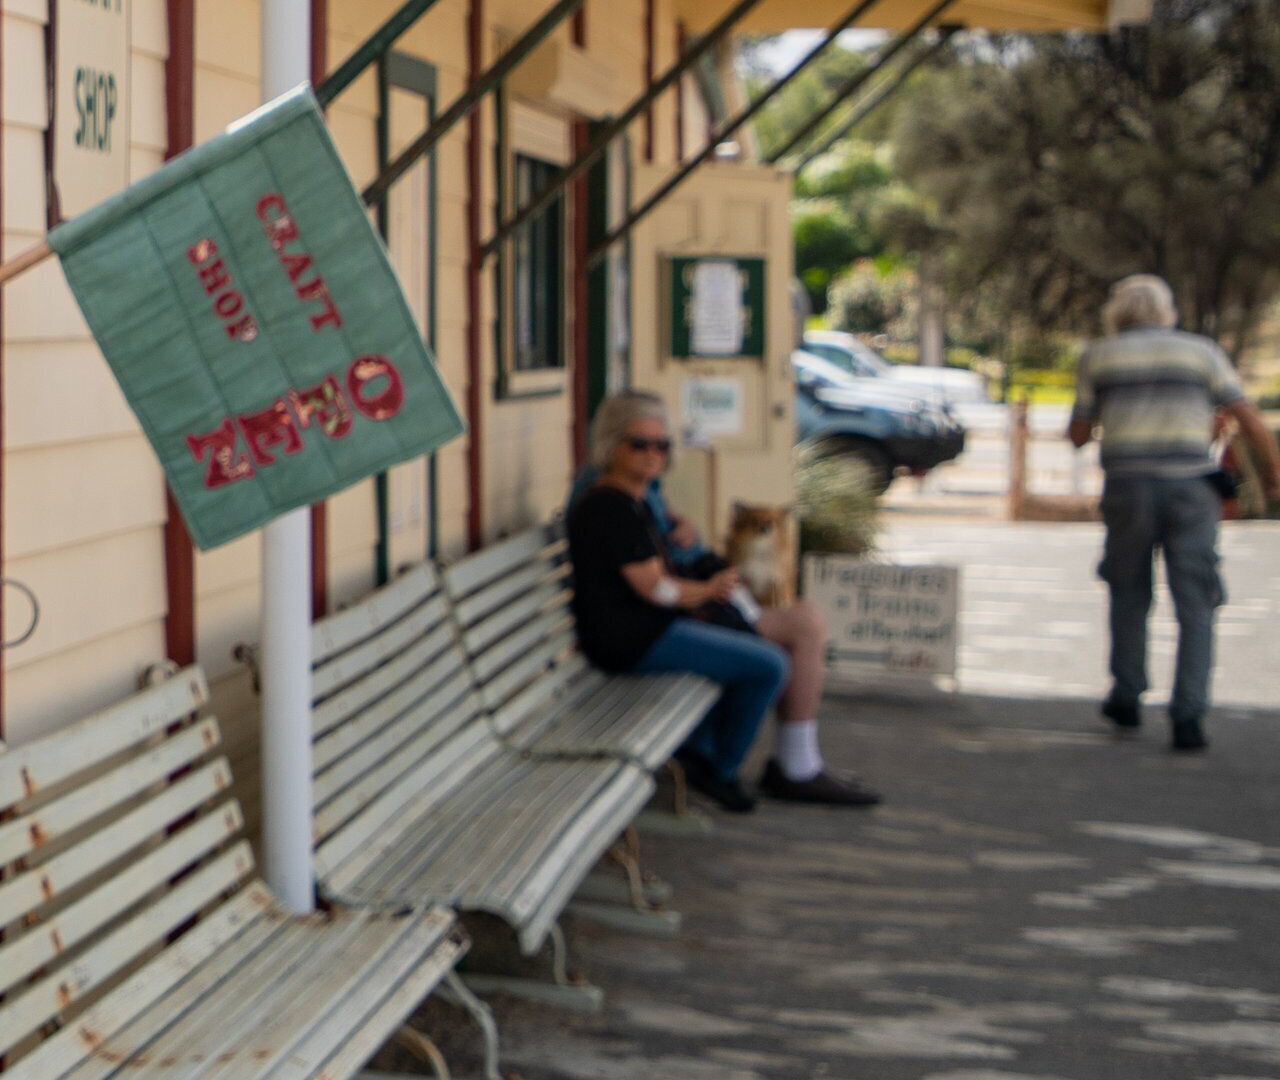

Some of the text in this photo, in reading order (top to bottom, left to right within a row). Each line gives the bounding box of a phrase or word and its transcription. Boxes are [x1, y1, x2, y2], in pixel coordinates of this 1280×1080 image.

[74, 65, 118, 153] SHOP
[186, 237, 258, 342] SHOP
[255, 192, 344, 333] CRAFT
[185, 353, 406, 490] OPEN
